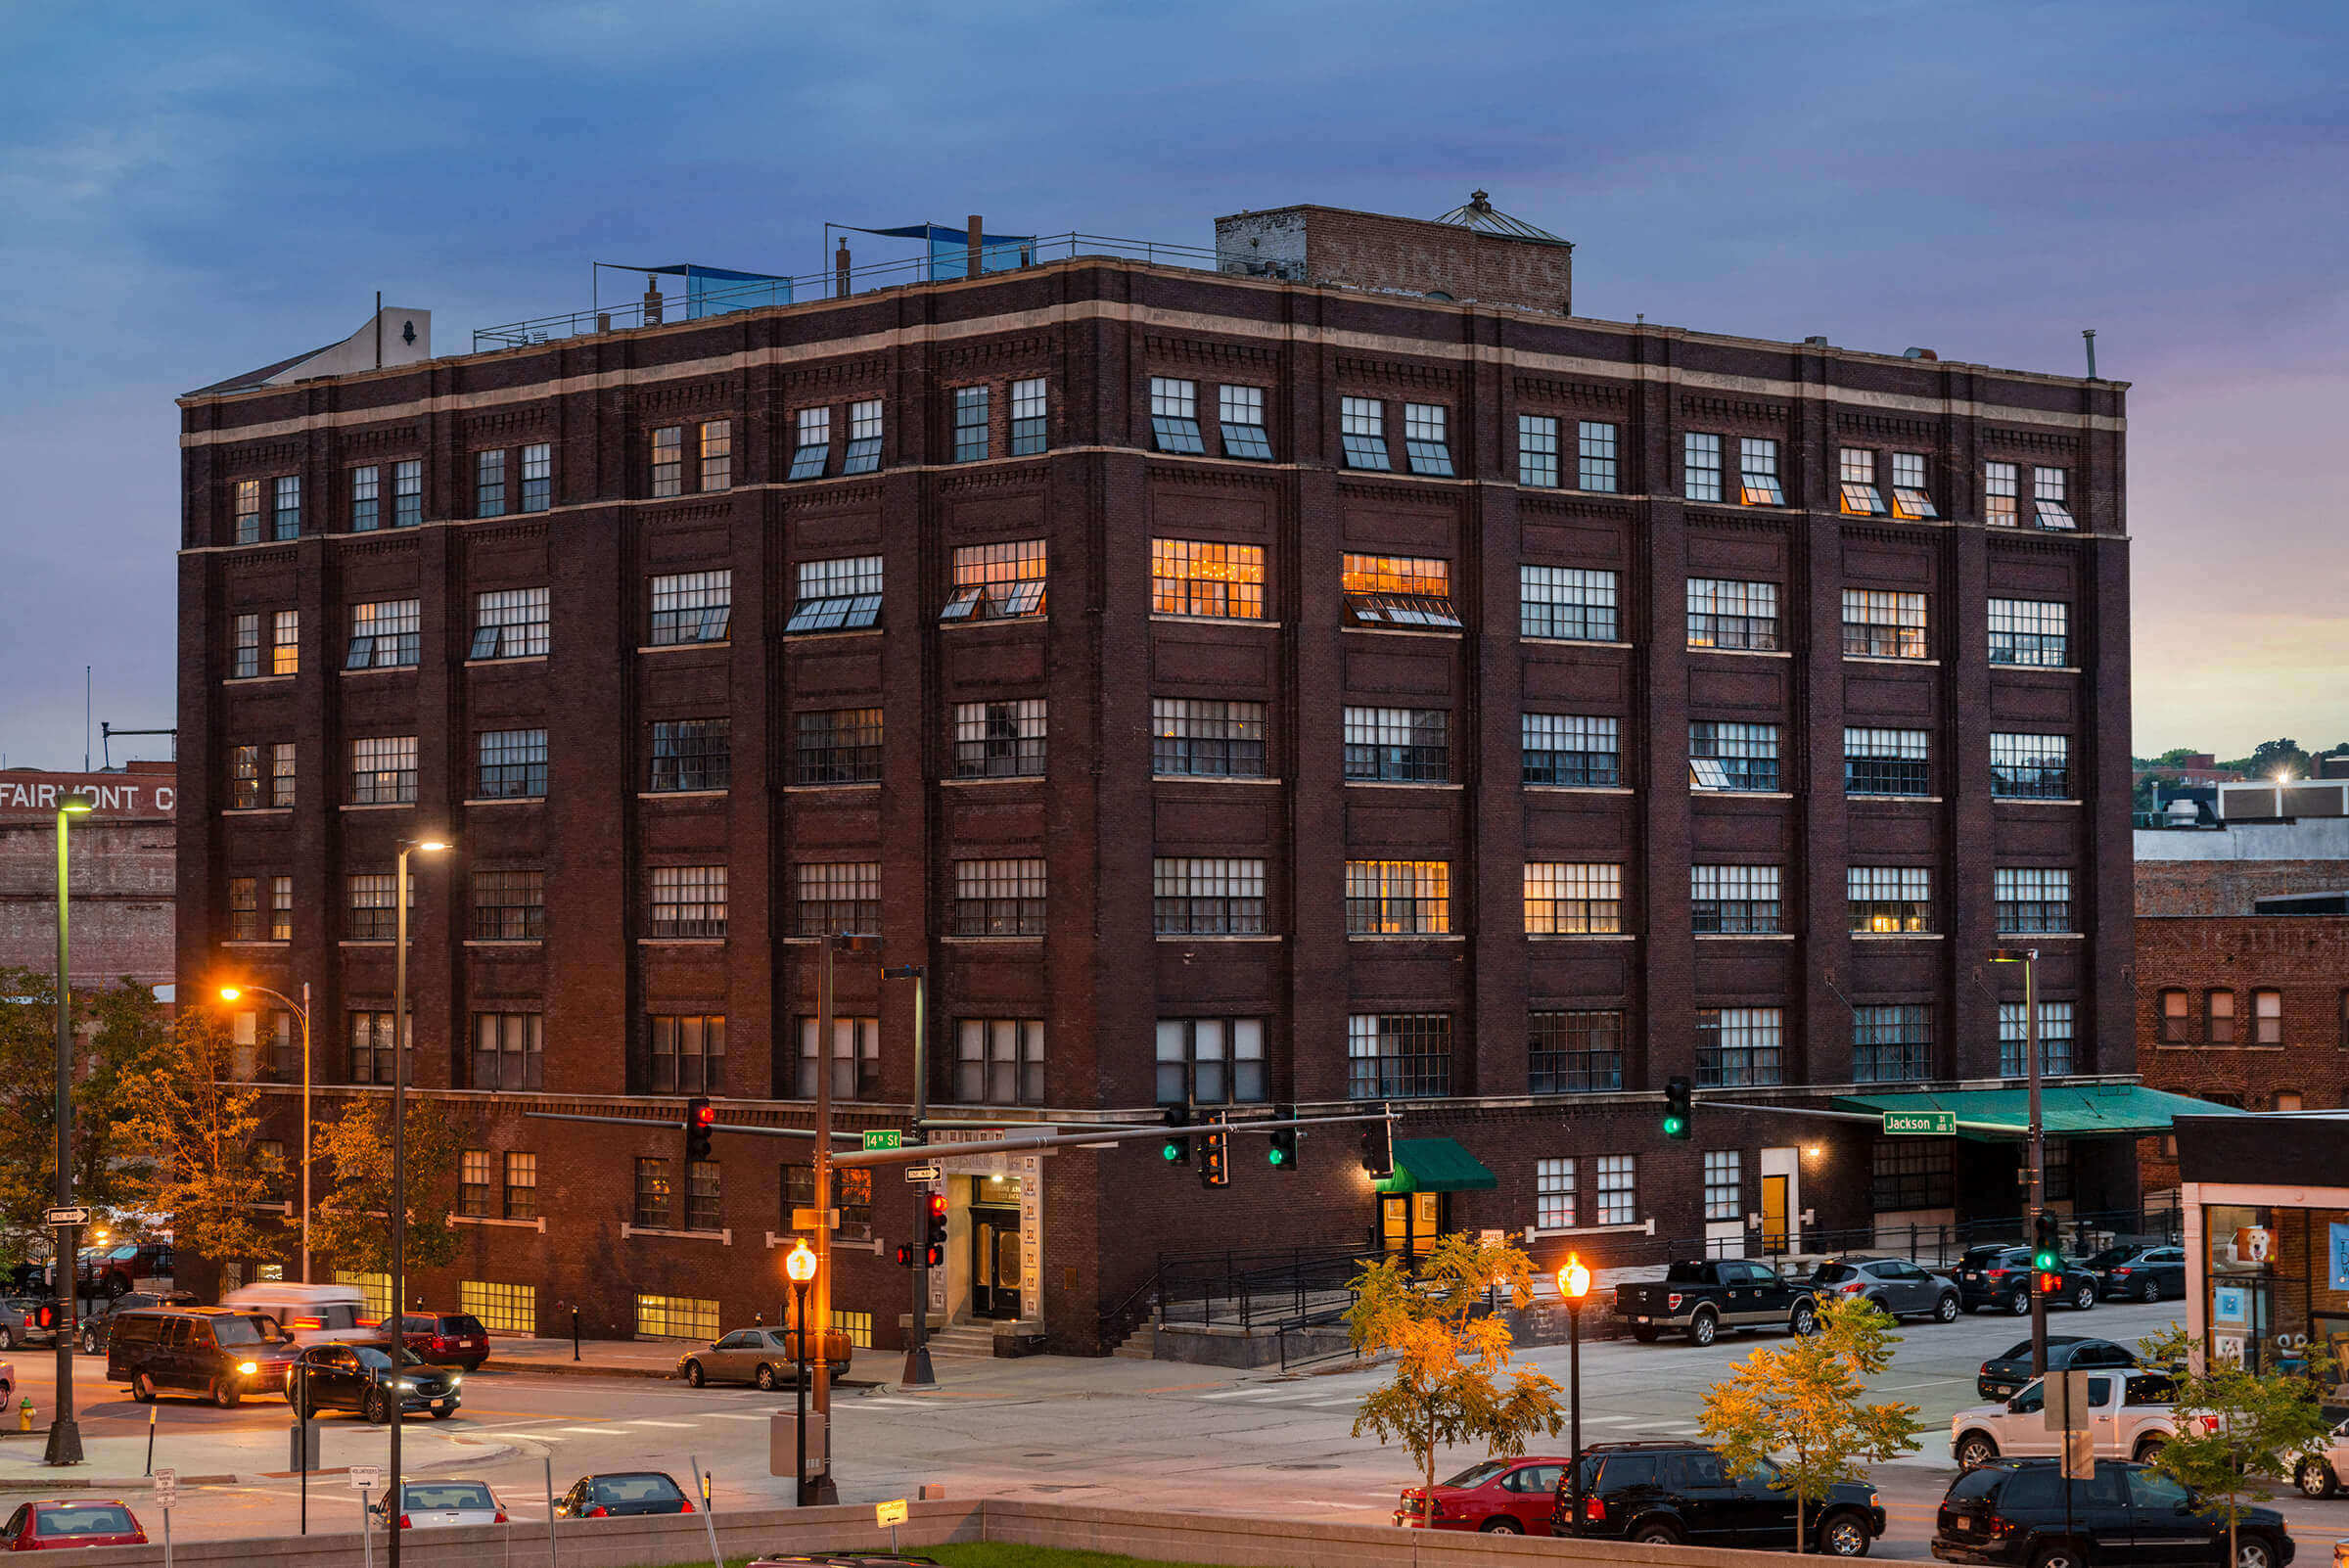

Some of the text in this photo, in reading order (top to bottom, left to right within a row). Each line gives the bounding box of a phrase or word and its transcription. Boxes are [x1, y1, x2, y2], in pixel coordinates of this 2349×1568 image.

[156, 787, 177, 810] C
[1887, 1116, 1930, 1130] Jackson
[887, 1134, 898, 1146] St
